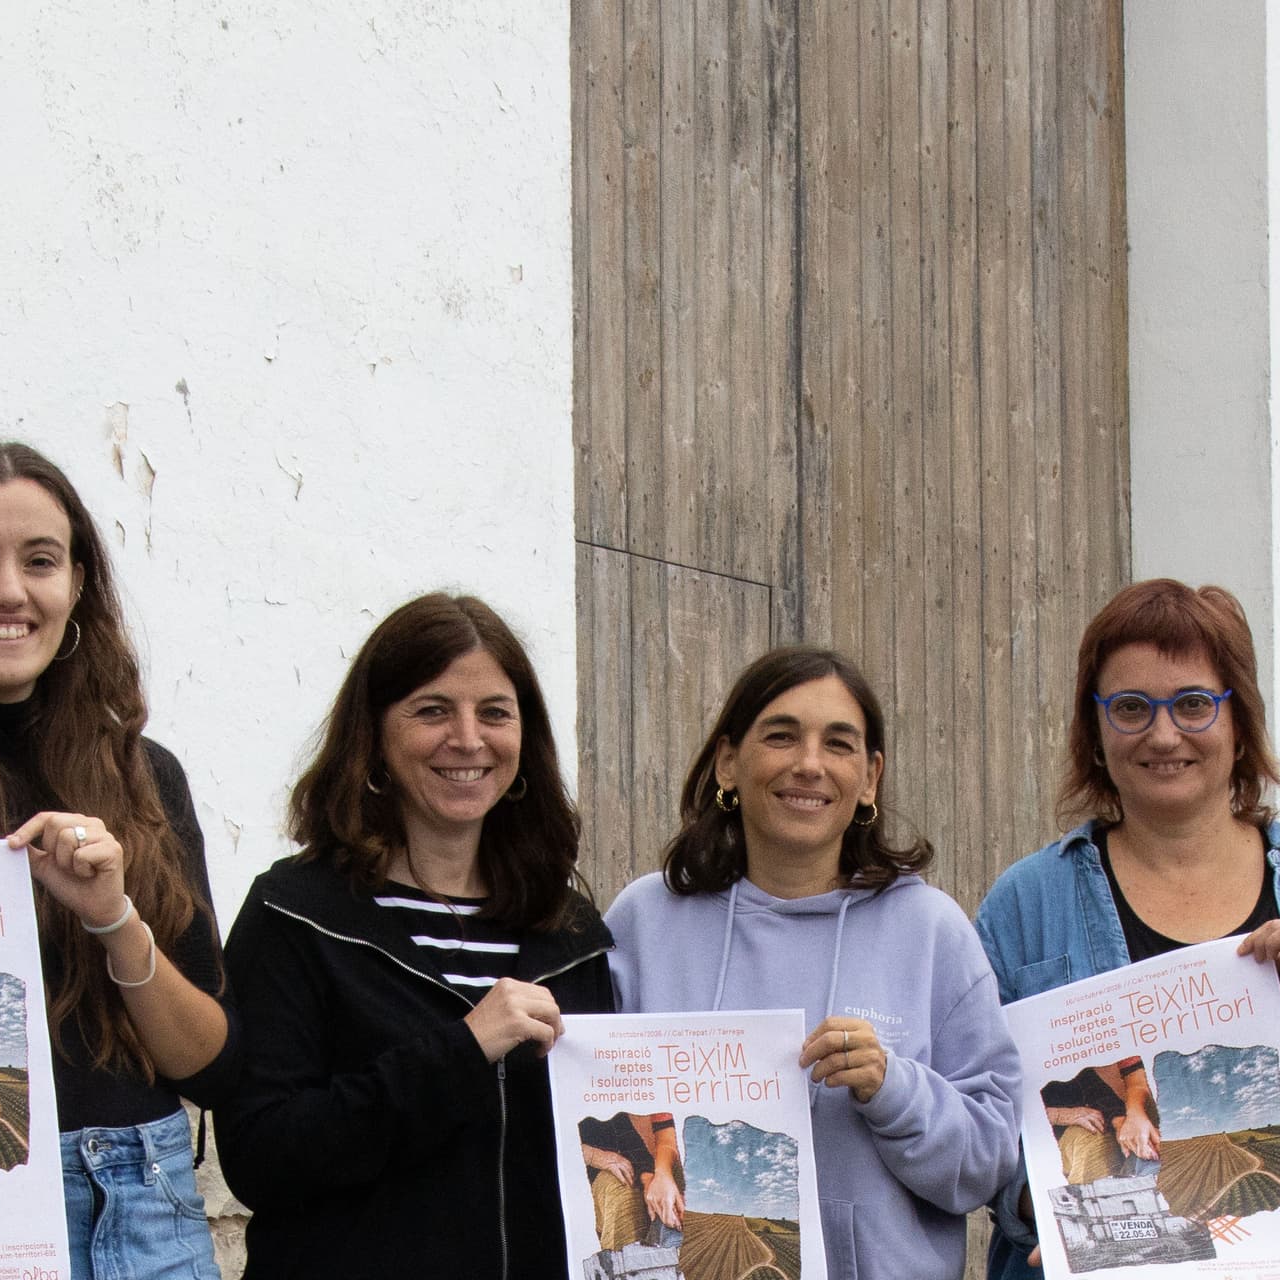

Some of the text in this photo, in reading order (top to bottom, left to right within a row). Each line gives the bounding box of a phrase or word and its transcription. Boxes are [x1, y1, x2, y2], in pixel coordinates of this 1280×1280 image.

[844, 1006, 903, 1025] euphoria
[1049, 1000, 1113, 1029] inspiració
[1072, 1015, 1116, 1036] reptes
[1057, 1028, 1119, 1052] solucions
[594, 1046, 651, 1061] inspiració
[1043, 1040, 1121, 1070] comparides
[614, 1062, 653, 1076] reptes
[597, 1076, 654, 1088] solucions
[583, 1090, 656, 1105] comparides
[1120, 1220, 1154, 1230] VENDA
